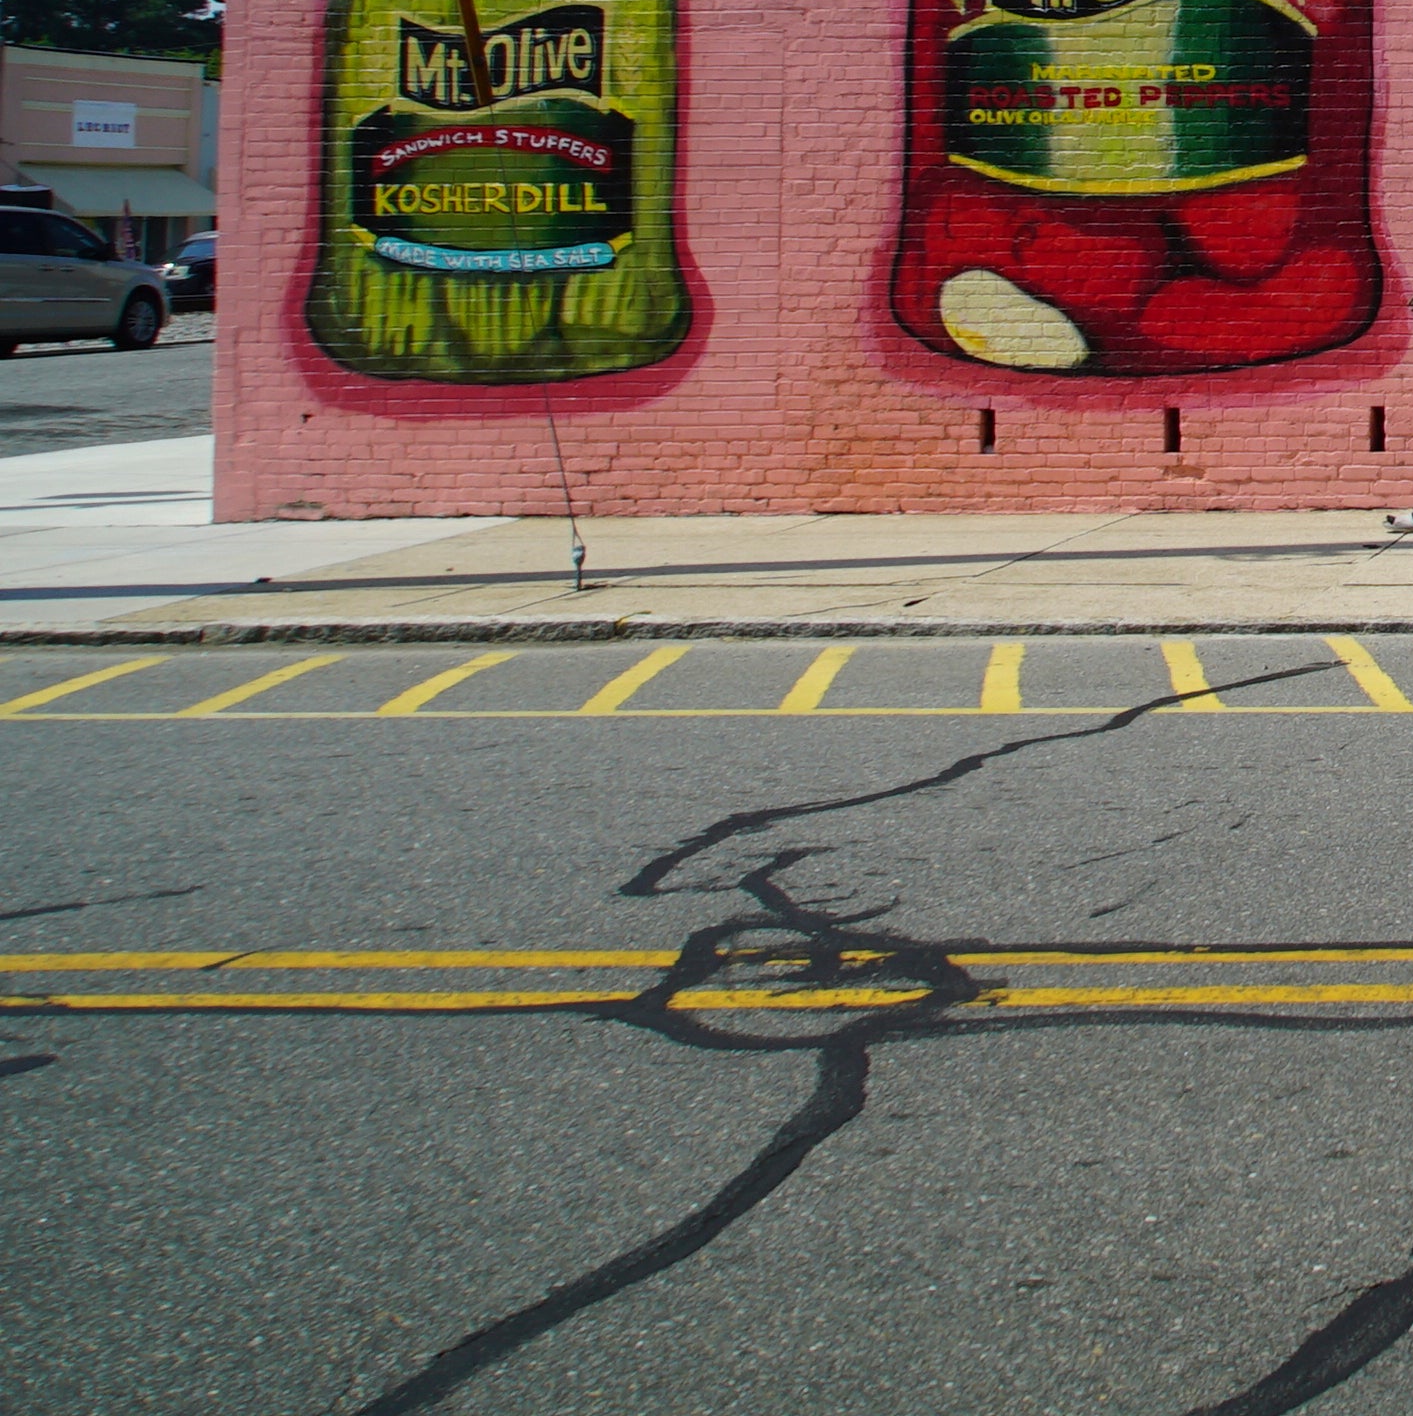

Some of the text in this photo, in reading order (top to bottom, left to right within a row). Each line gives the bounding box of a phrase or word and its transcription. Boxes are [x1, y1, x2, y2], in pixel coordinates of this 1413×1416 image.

[406, 28, 594, 103] Mt. Olive
[969, 85, 1291, 109] ROASTED PEPPERS
[969, 110, 1027, 125] OLIVE
[380, 129, 610, 167] SANDWICH STUFFERS
[374, 182, 607, 217] KOSHER DILL
[379, 241, 602, 269] MADE WITH SEA SALT
